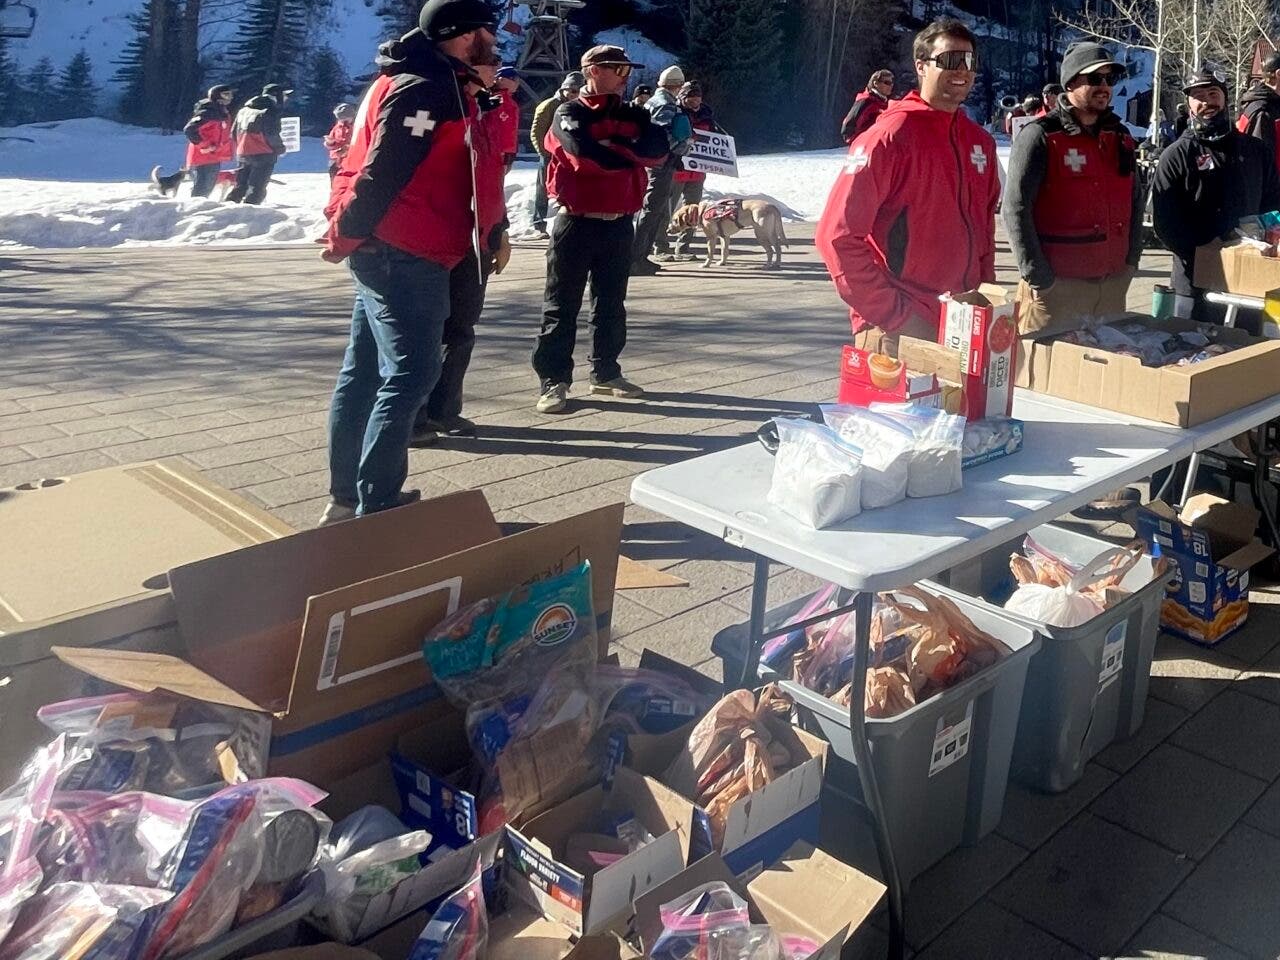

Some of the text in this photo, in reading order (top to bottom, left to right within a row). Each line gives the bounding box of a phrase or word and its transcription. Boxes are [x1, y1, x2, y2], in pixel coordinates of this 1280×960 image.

[712, 136, 729, 148] ON
[972, 317, 982, 336] CANS
[996, 355, 1005, 388] DICED
[1193, 541, 1209, 557] 18
[534, 620, 576, 642] SUNSET
[538, 863, 560, 883] VARIETY
